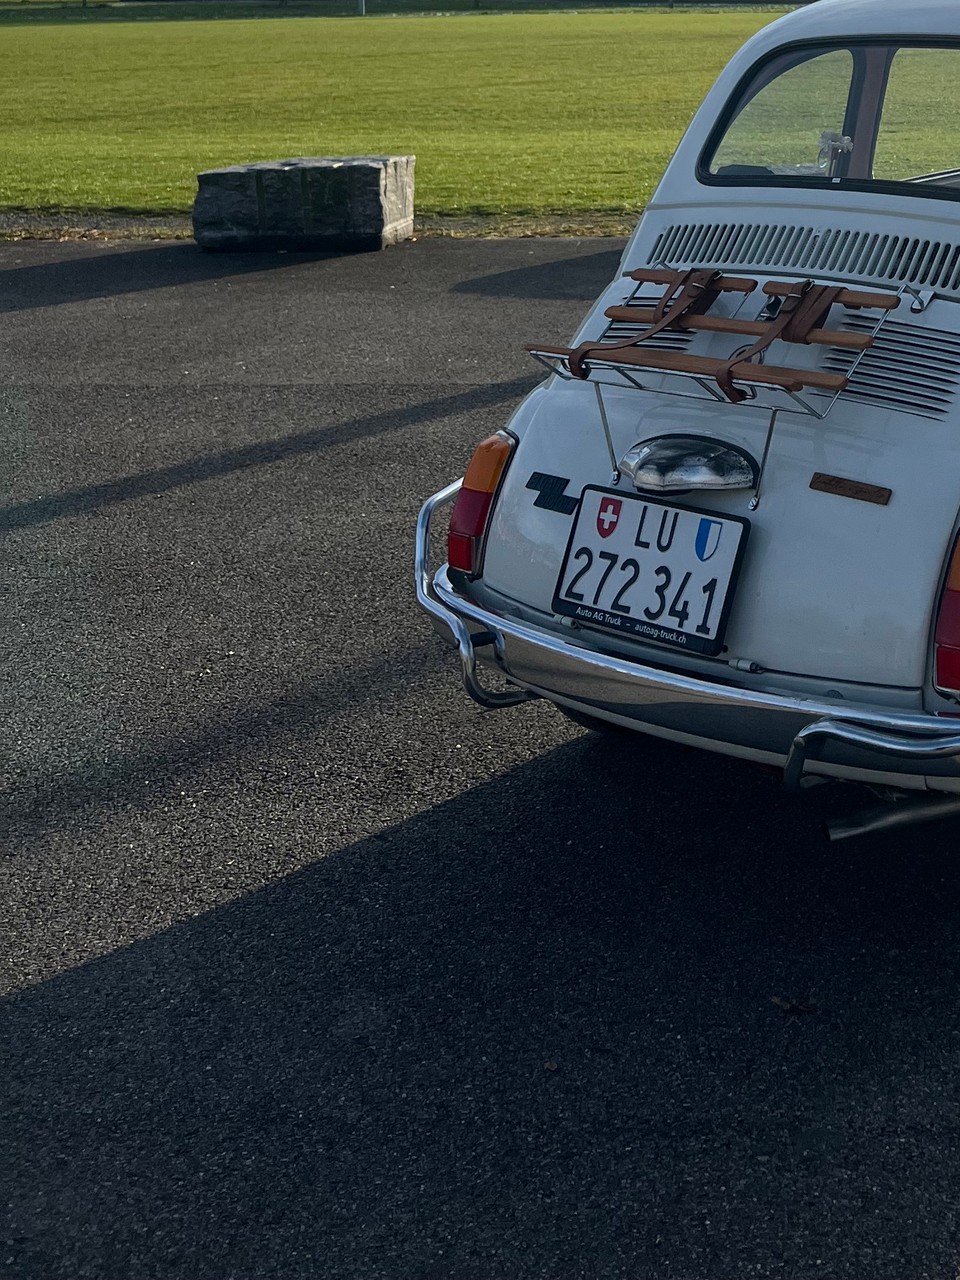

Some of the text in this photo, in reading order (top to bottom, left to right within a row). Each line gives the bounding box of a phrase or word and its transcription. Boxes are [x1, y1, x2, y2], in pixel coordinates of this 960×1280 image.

[634, 506, 679, 552] LU
[576, 606, 593, 618] Auto
[592, 610, 604, 621] AG
[604, 613, 622, 626] Truck
[635, 623, 687, 645] autoag-truck.ch
